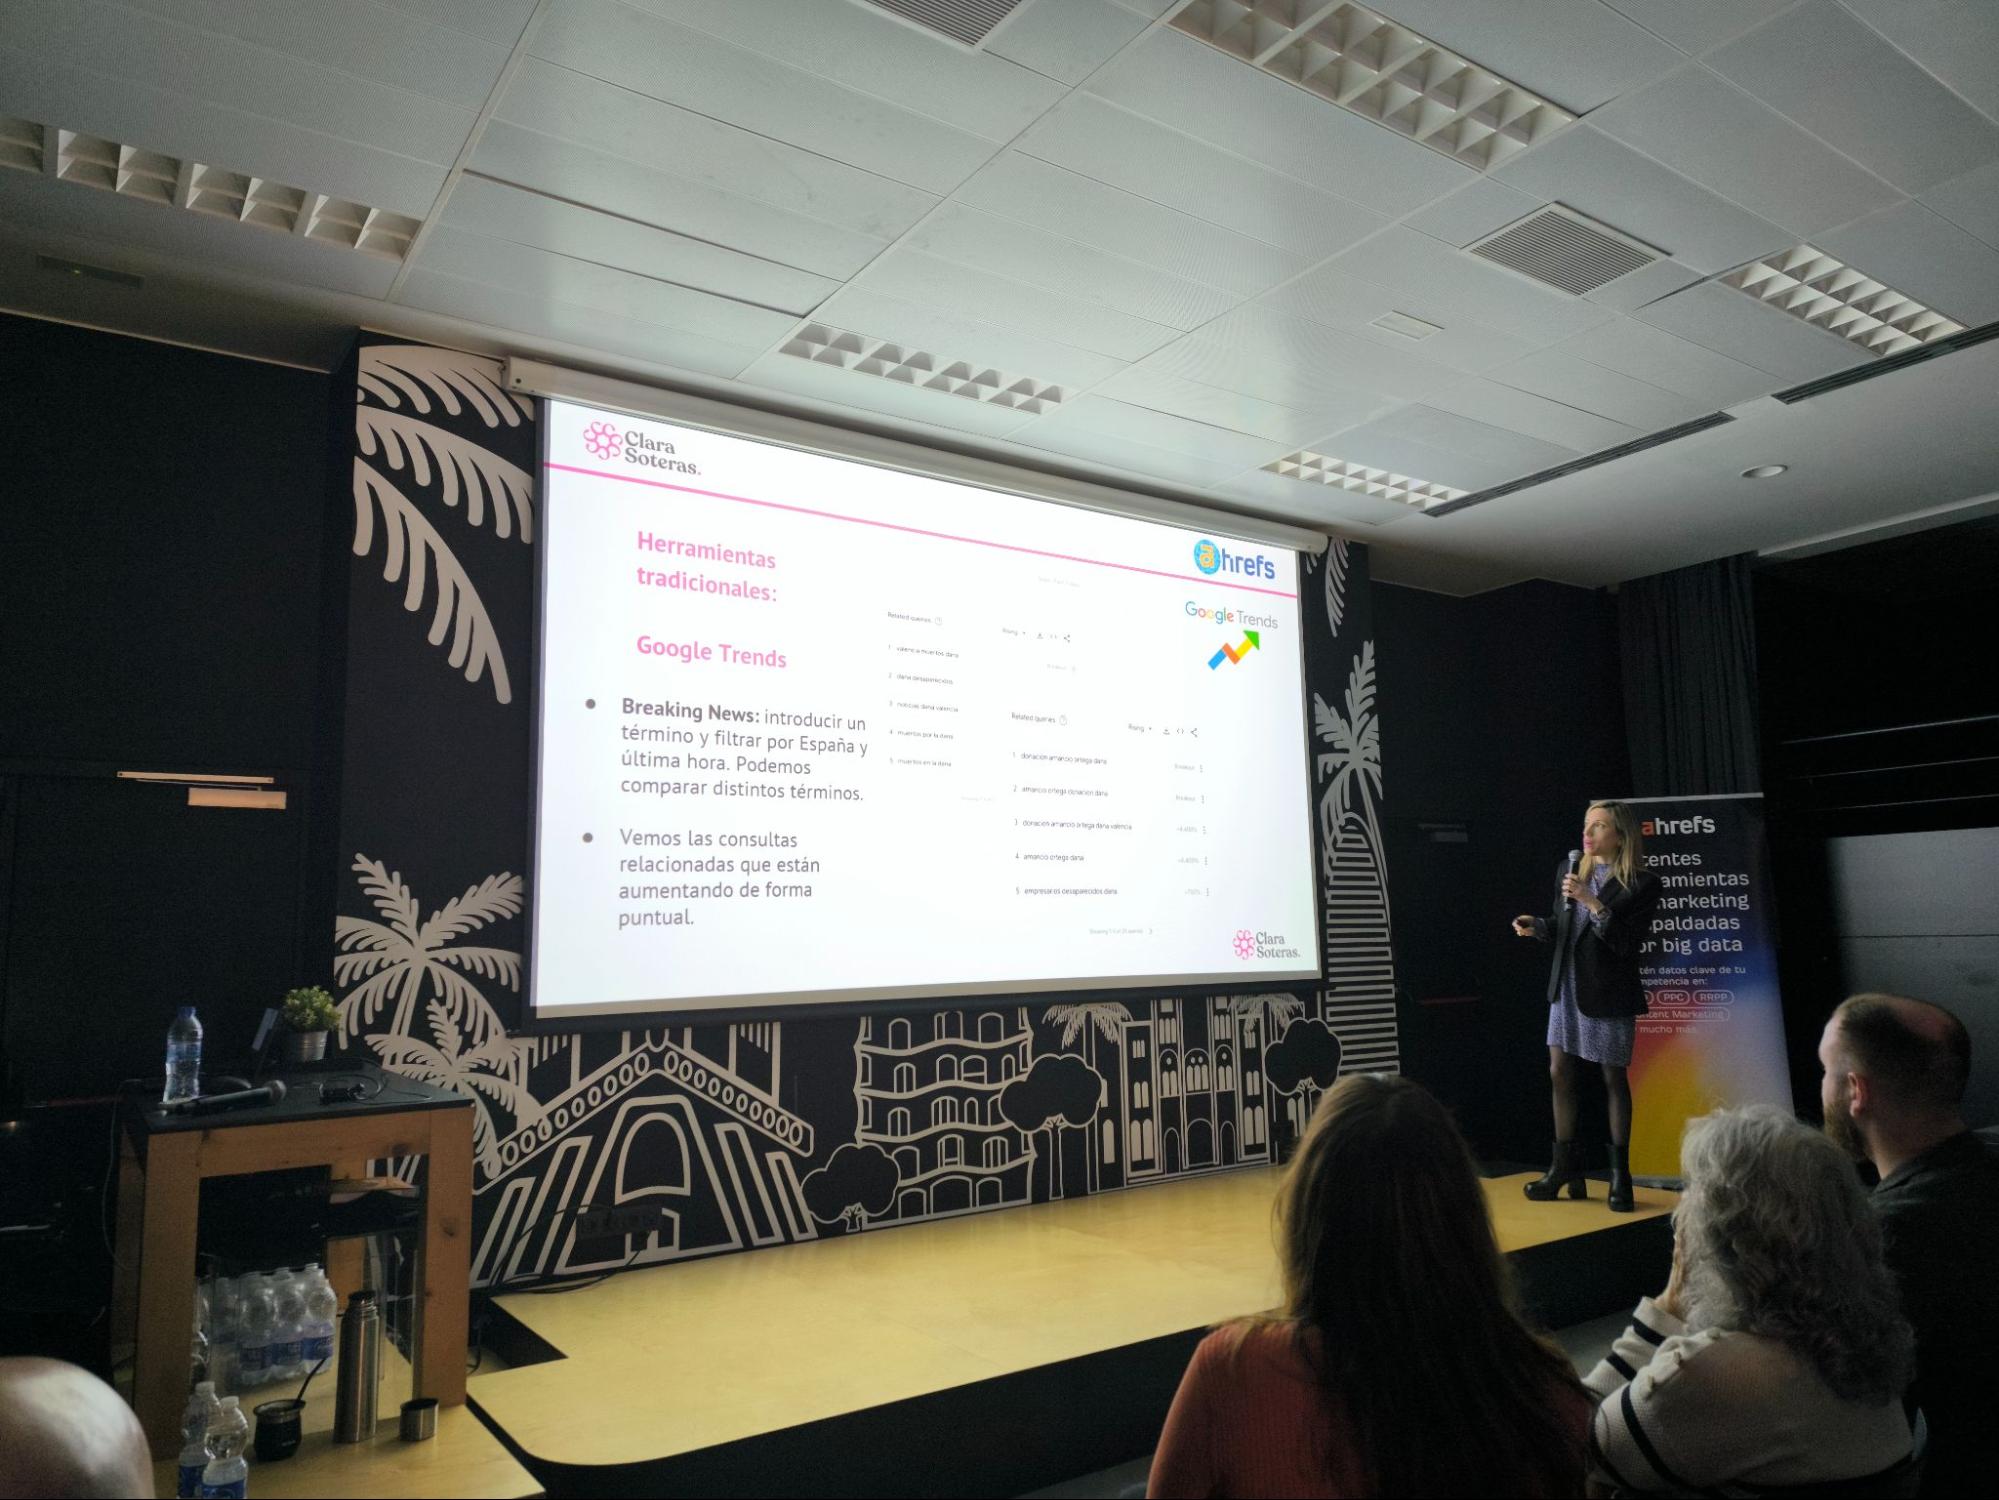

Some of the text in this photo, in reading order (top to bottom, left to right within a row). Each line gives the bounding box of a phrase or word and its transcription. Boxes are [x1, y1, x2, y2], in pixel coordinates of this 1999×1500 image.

[625, 430, 675, 455] Clara
[625, 448, 701, 476] Soteras.
[638, 531, 776, 569] Herramientas
[1199, 544, 1275, 579] ahrefs
[637, 566, 777, 602] tradicionales:
[1186, 601, 1278, 629] Google Trends
[637, 635, 787, 669] Google Trends
[622, 698, 866, 731] Breaking News: introducir un
[1011, 712, 1033, 722] Related
[622, 724, 868, 758] término y filtrar por España y
[622, 749, 811, 774] última hora. Podemos
[622, 779, 863, 801] comparar distintos términos.
[1642, 816, 1716, 835] ahrefs
[620, 829, 797, 847] Vemos las consultas
[620, 856, 820, 875] relacionadas que están
[1644, 853, 1702, 866] entes
[1662, 872, 1749, 888] amientas
[619, 882, 812, 899] aumentando de forma
[1657, 893, 1750, 911] arketing
[619, 908, 694, 930] puntual.
[1649, 916, 1740, 934] paldadas
[1256, 932, 1285, 944] Clara
[1663, 938, 1692, 955] big
[1698, 938, 1742, 952] data
[1257, 946, 1300, 958] Soteras.
[1639, 966, 1656, 975] tén
[1659, 966, 1687, 975] datos
[1719, 966, 1731, 974] de
[1734, 966, 1746, 974] tu
[1664, 993, 1684, 1001] PPC
[1699, 993, 1728, 1001] RRPP
